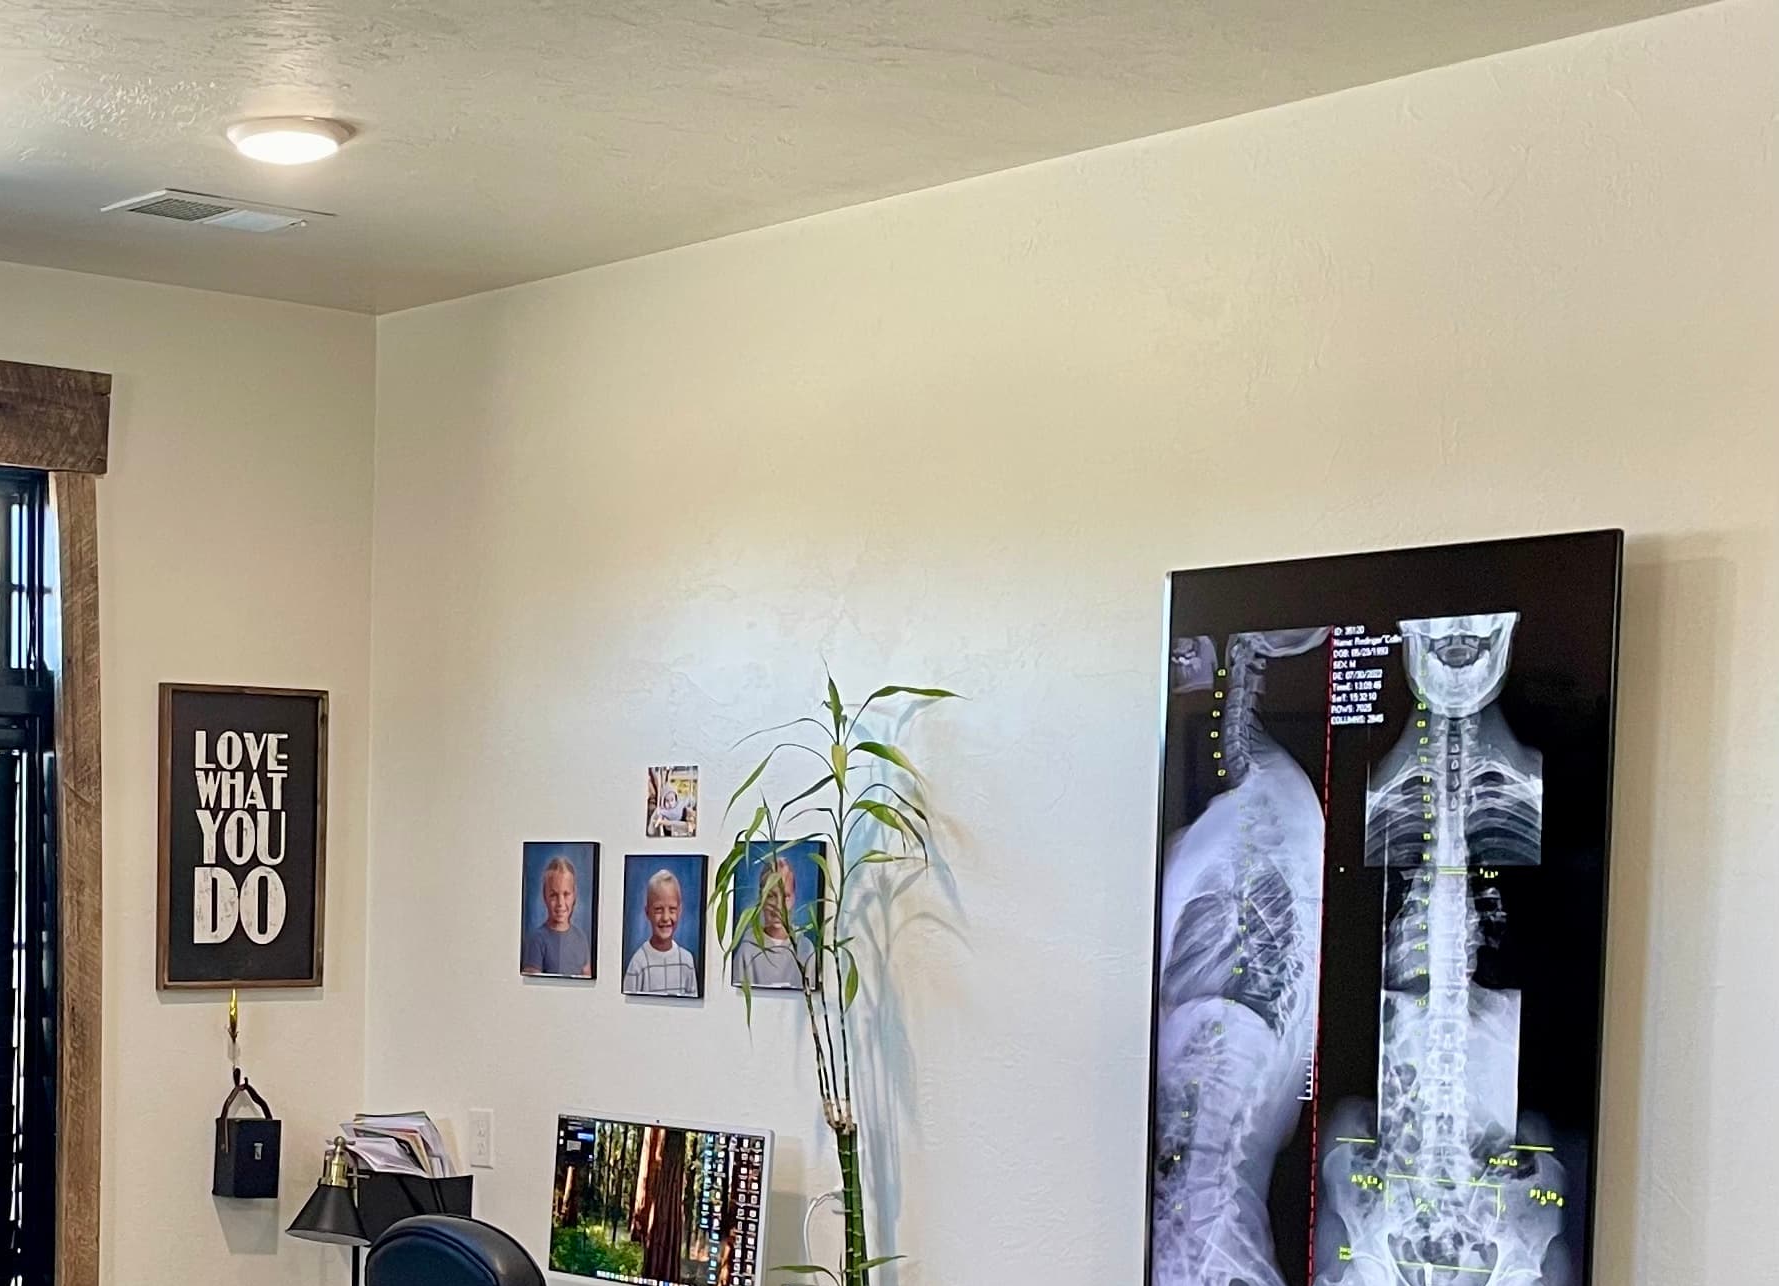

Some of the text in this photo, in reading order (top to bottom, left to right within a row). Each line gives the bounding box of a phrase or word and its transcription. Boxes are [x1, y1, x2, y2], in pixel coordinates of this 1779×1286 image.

[194, 730, 288, 771] LOVE
[195, 770, 287, 810] WHAT
[195, 809, 286, 865] YOU
[193, 866, 286, 944] DO
